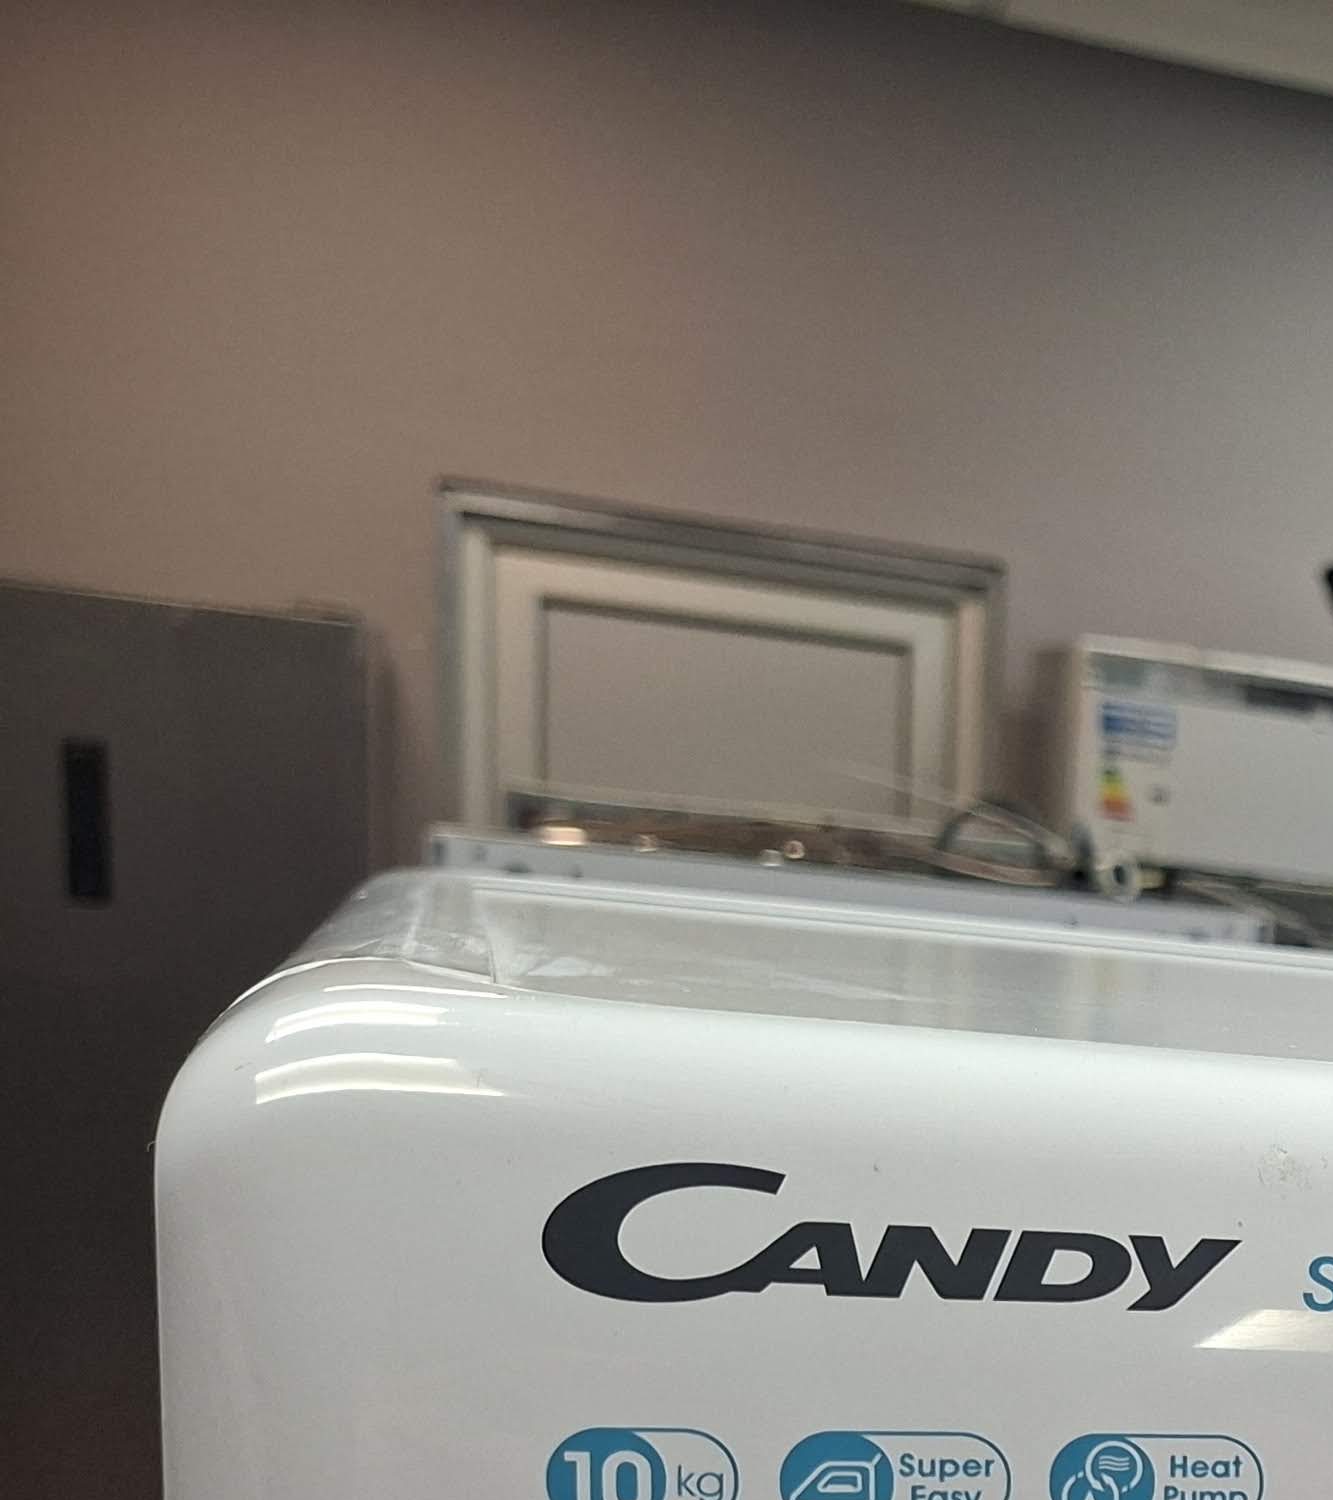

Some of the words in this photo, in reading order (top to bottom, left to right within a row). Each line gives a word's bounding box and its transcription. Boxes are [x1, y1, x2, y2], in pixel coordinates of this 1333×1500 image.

[542, 1162, 1242, 1311] CANDY
[898, 1453, 995, 1483] Super
[1169, 1455, 1244, 1480] Heat
